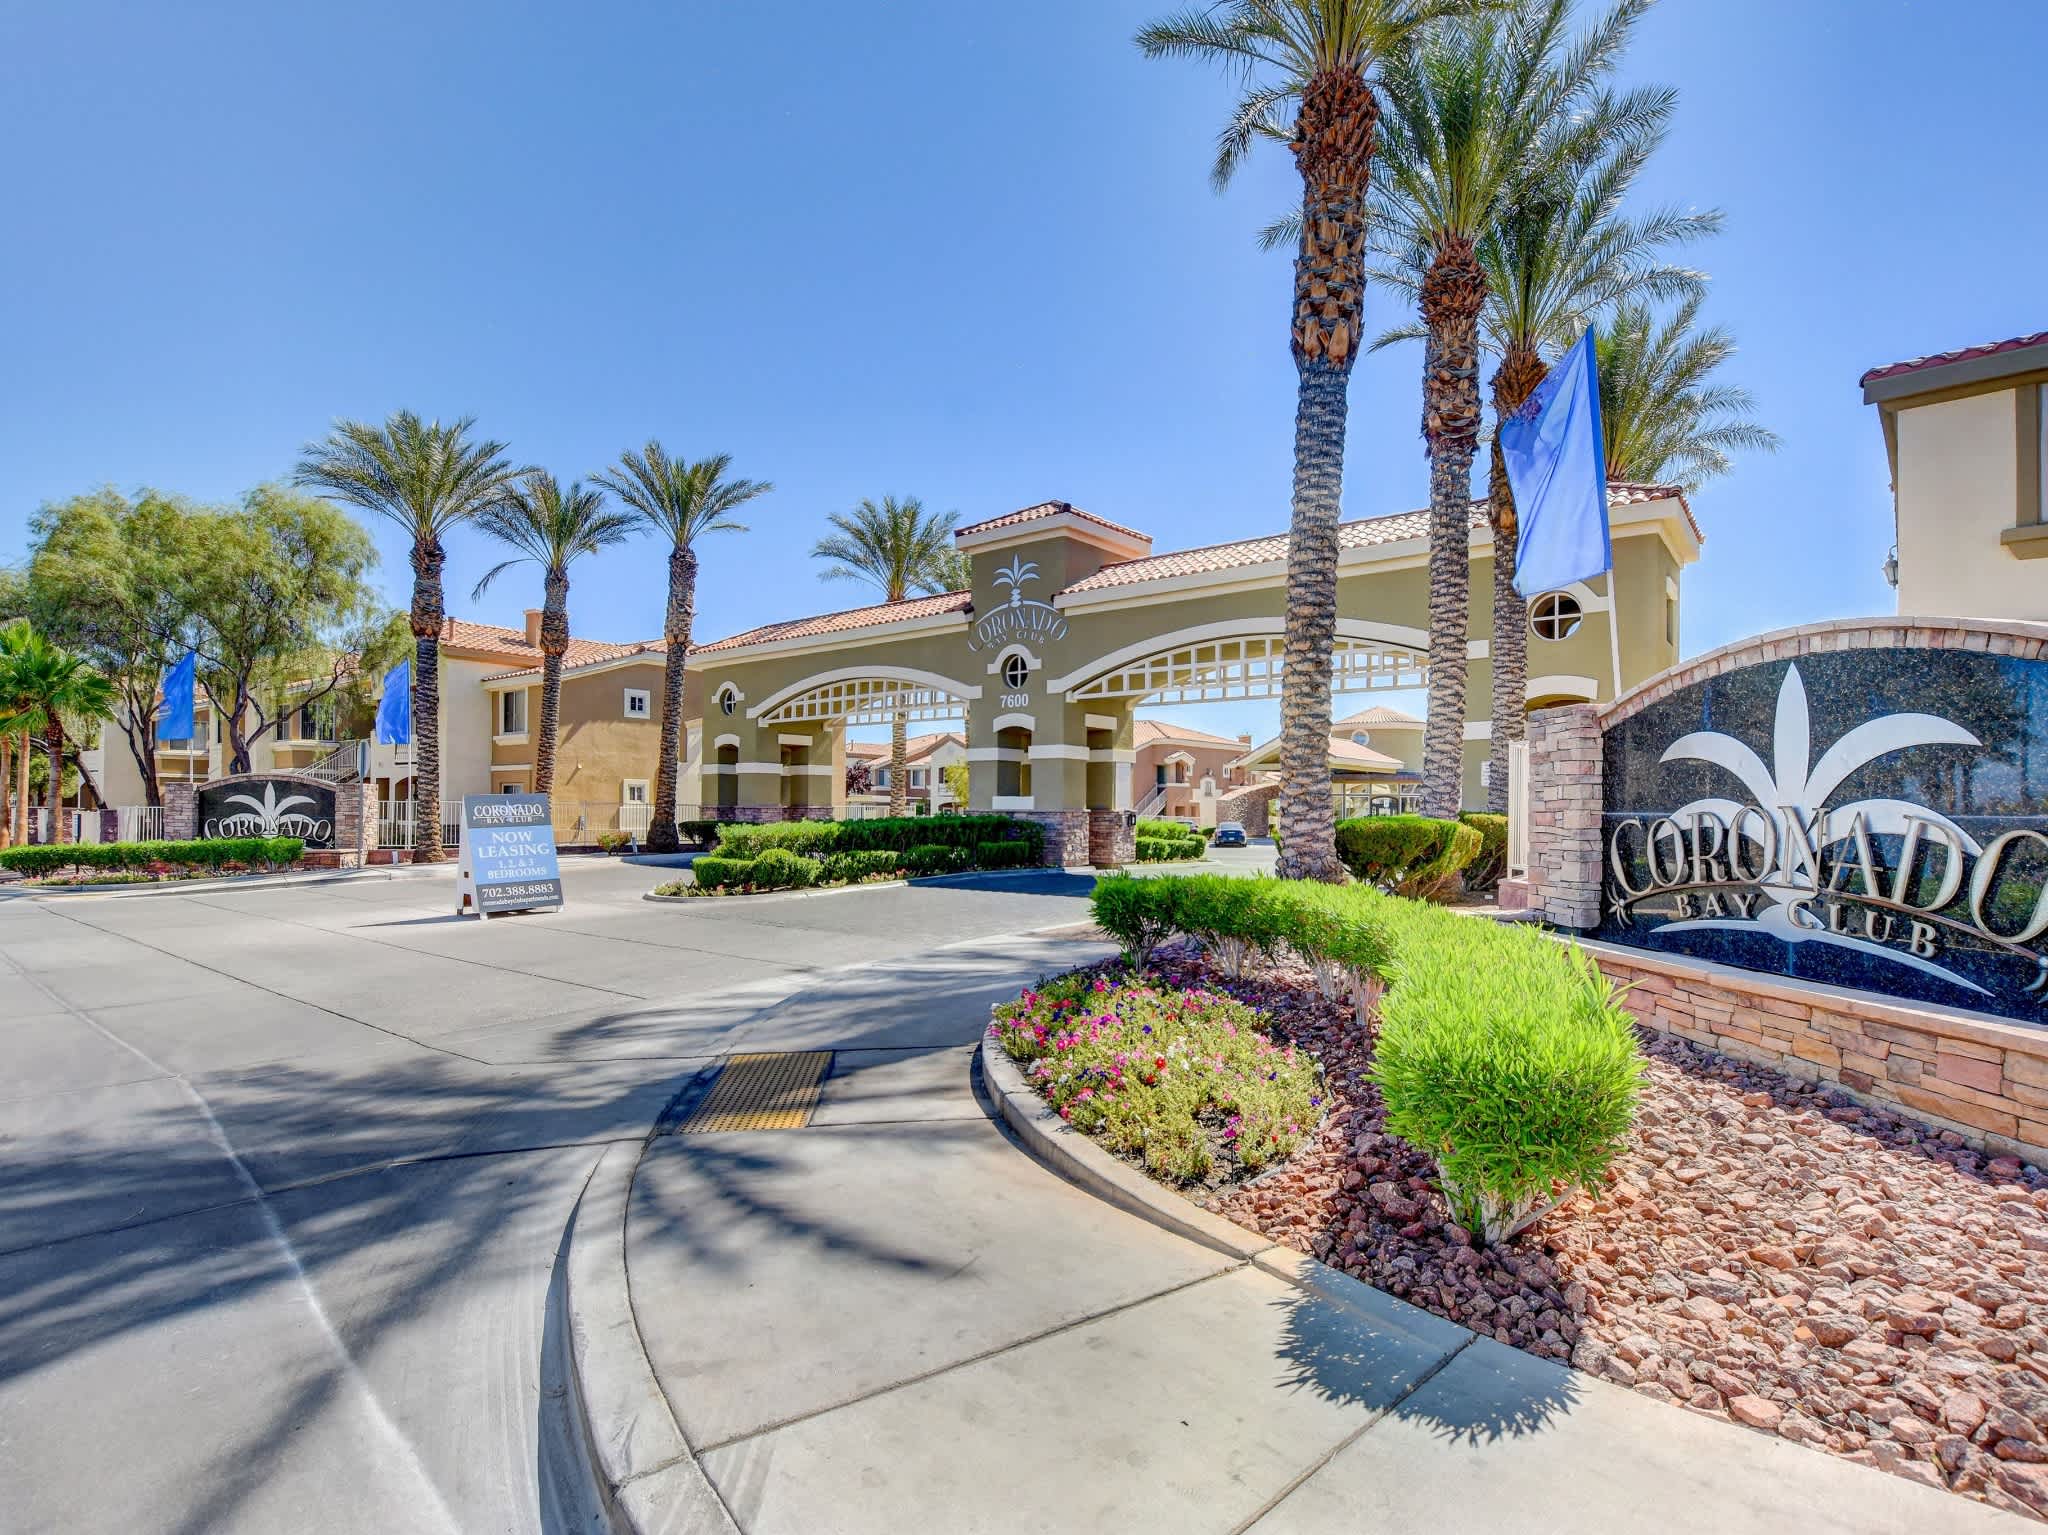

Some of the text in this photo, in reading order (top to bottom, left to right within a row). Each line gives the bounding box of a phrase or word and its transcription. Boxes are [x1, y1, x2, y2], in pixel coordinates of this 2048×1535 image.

[1000, 693, 1029, 708] 7600
[473, 803, 542, 817] CORONADO
[204, 814, 332, 842] CORONADO
[492, 831, 532, 844] NOW
[478, 842, 550, 858] LEASING
[488, 866, 547, 880] BEDROOMS
[1610, 805, 2048, 943] CORONADO
[481, 883, 554, 898] 702.388.8883
[1675, 893, 1937, 958] BAY CLUB
